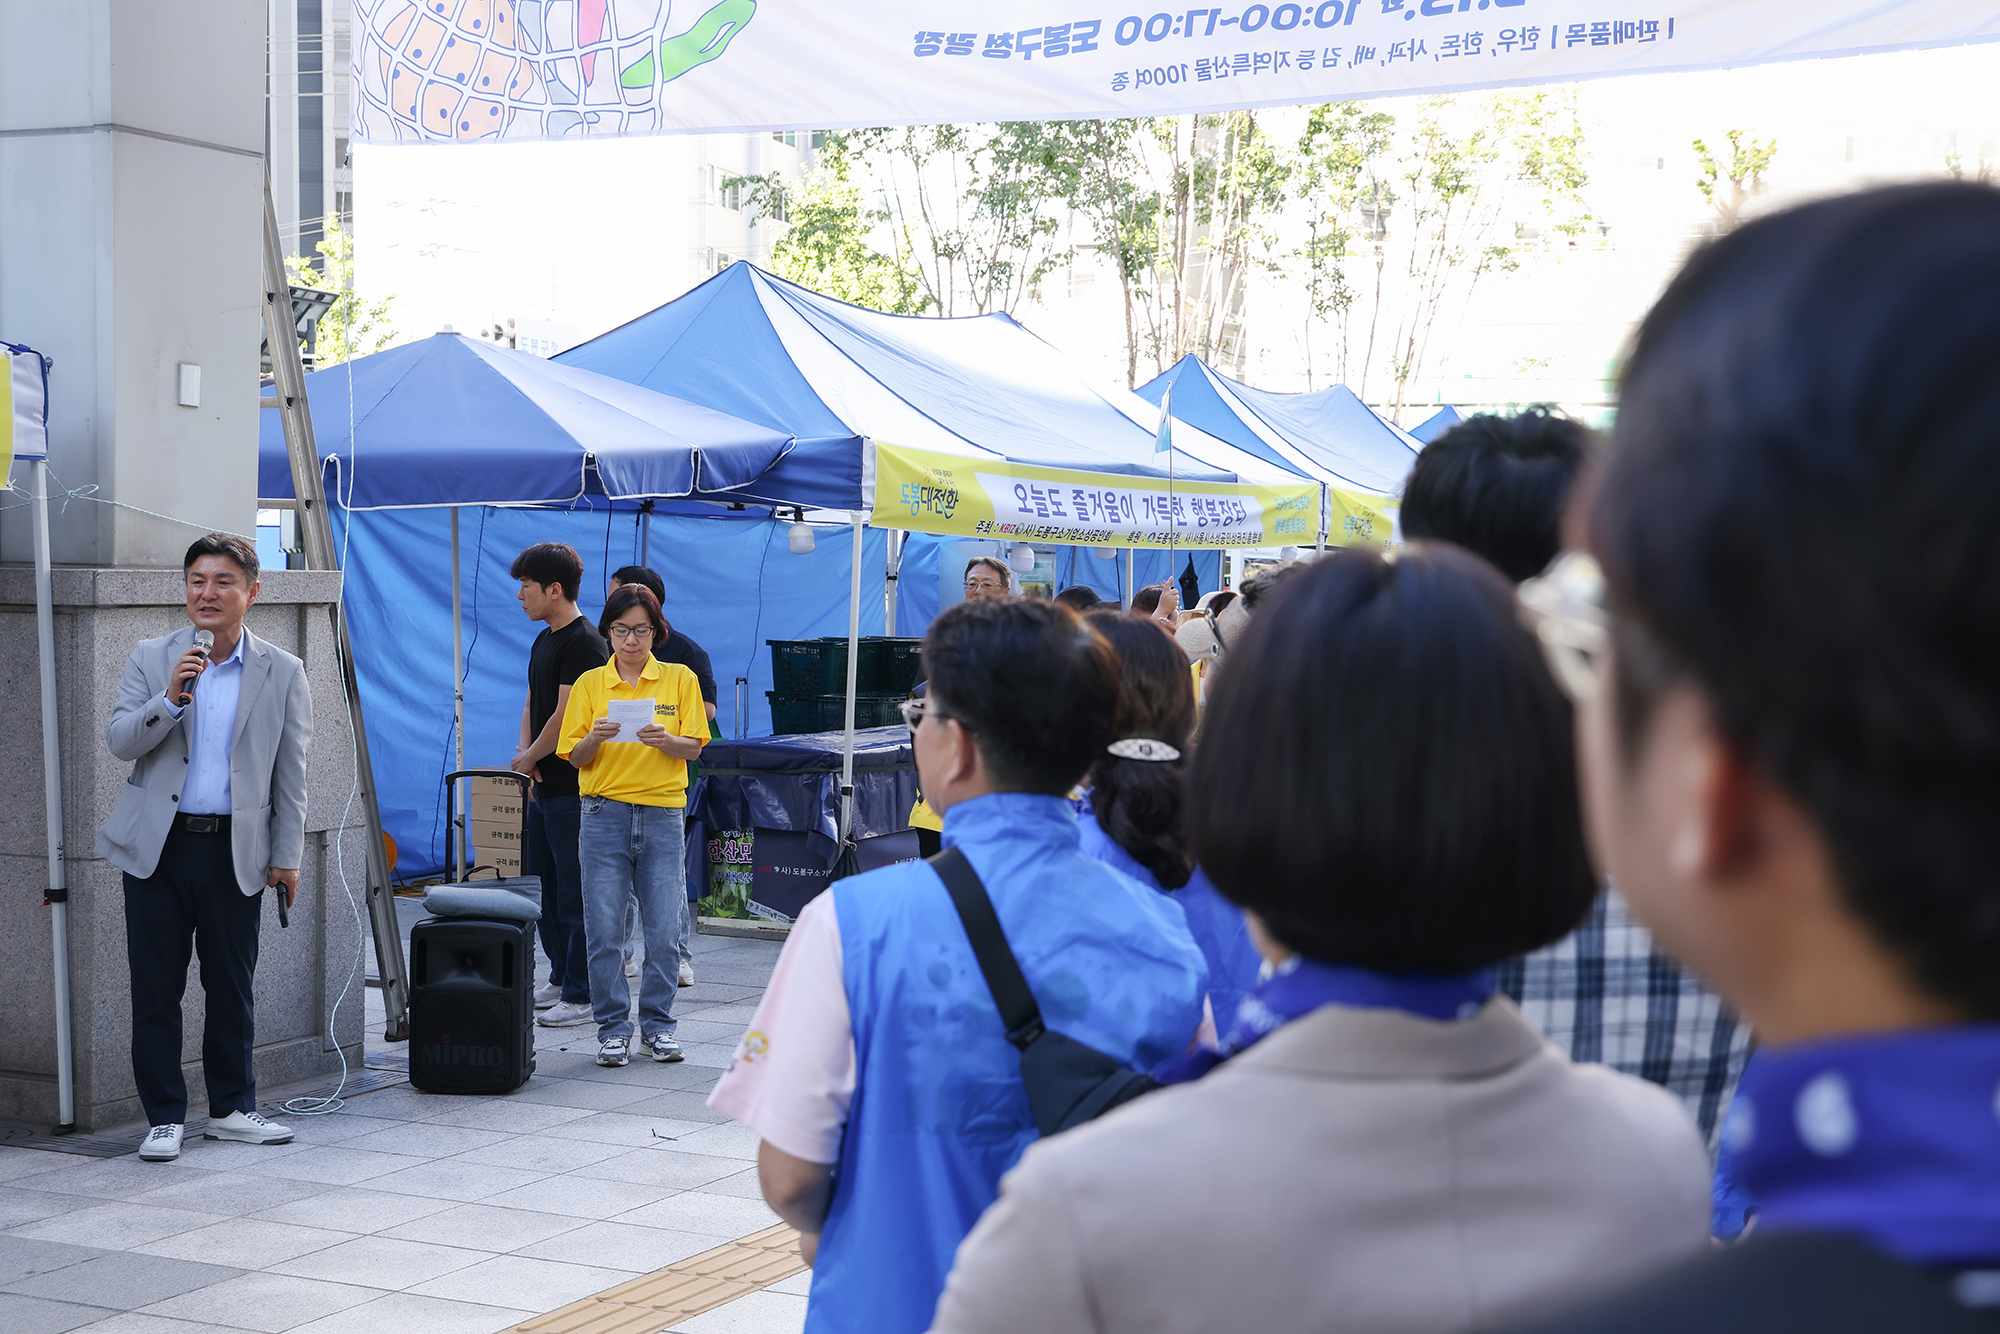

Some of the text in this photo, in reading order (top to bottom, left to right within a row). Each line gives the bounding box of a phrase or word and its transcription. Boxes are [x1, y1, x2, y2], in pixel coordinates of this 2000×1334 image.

[900, 482, 959, 519] 도봉대전환
[1014, 483, 1247, 527] 오늘도 즐거움이 가득한 행복장터
[998, 523, 1017, 535] KBIZ
[793, 867, 831, 878] 도봉구소기
